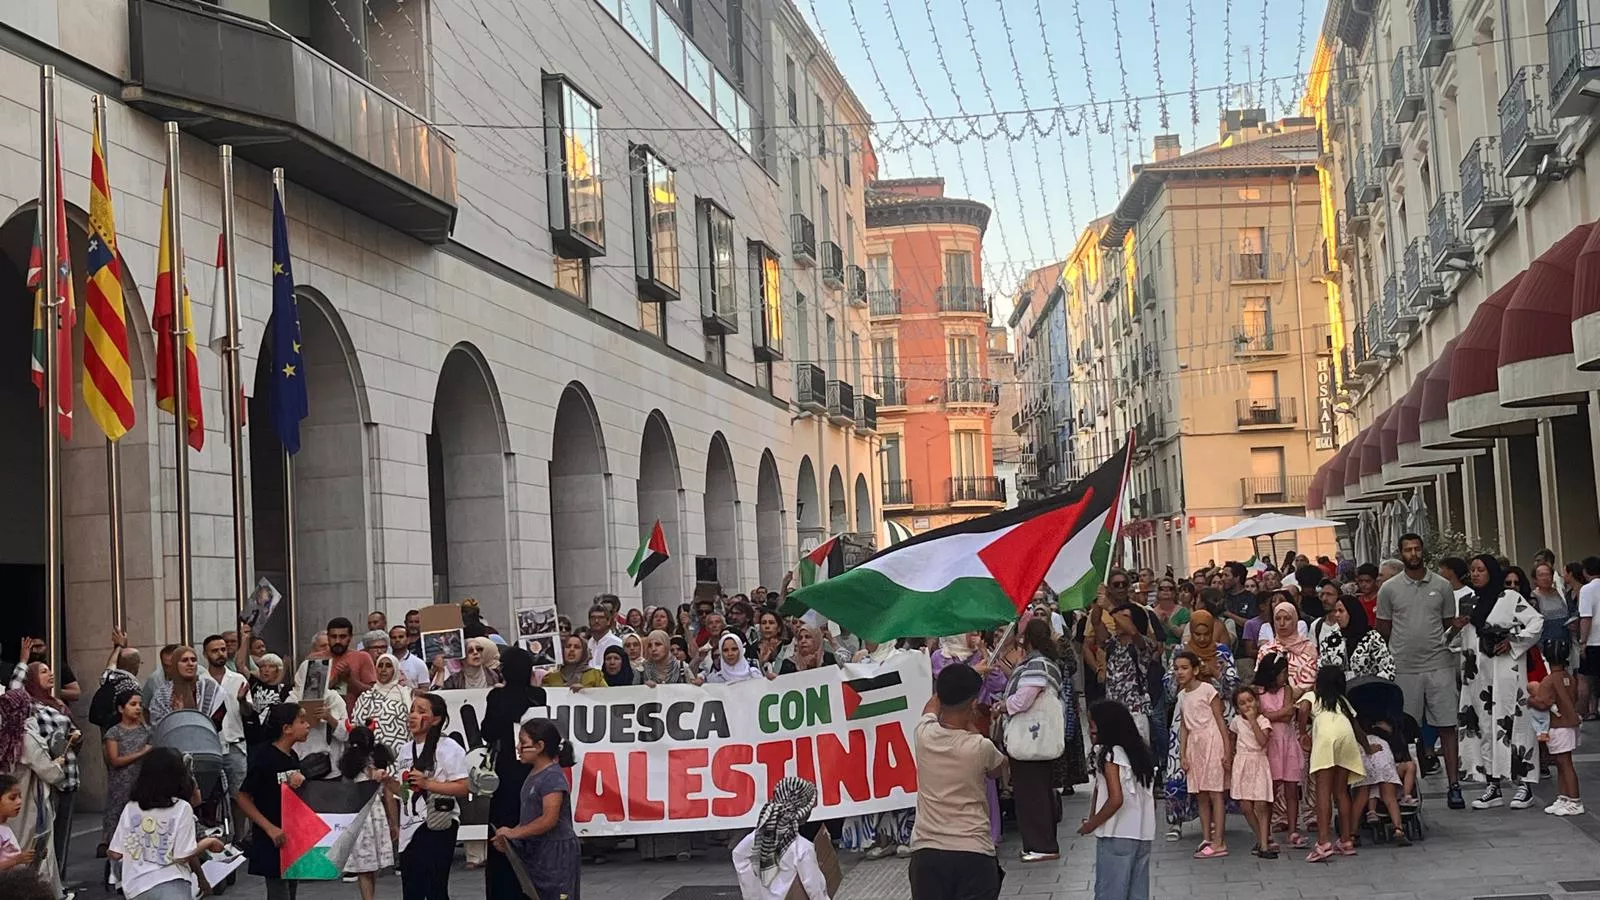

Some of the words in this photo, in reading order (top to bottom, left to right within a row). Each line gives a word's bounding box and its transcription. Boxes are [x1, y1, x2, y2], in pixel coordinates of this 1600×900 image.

[1317, 359, 1331, 434] HOSTAL
[758, 684, 832, 734] CON
[562, 721, 918, 823] ALESTINA
